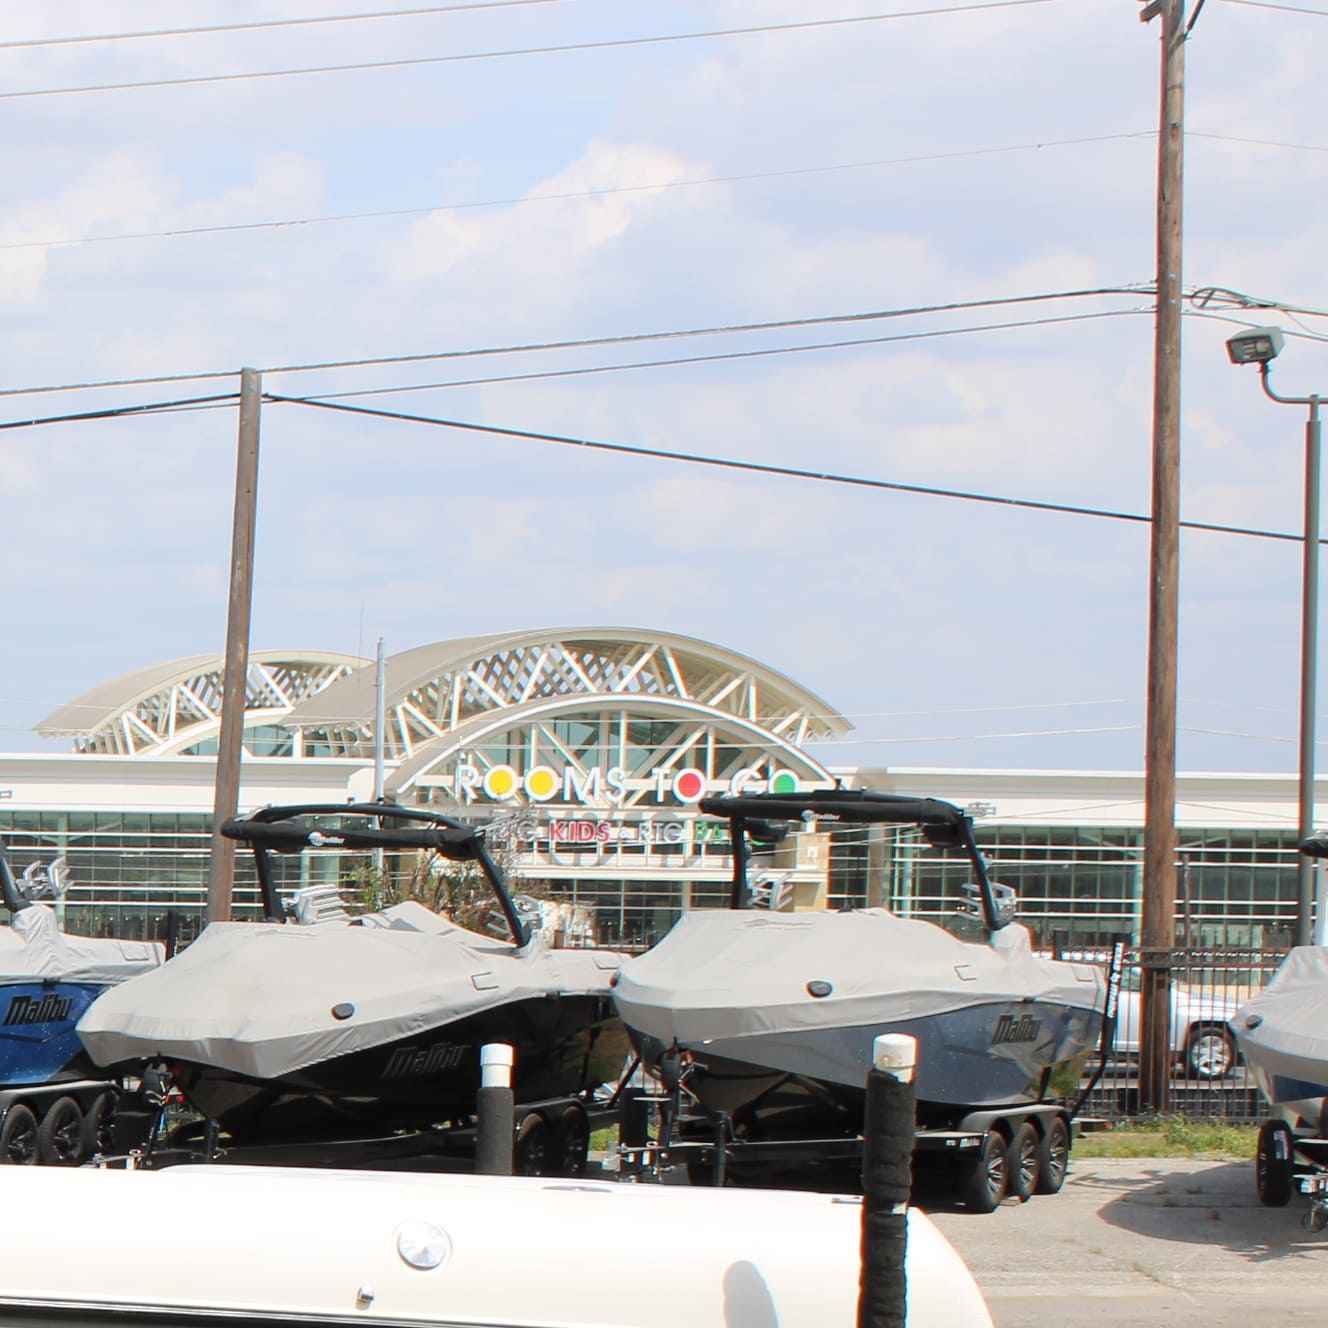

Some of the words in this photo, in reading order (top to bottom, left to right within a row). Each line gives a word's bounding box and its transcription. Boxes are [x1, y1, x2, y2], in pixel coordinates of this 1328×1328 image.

[455, 764, 626, 802] ROOMS
[652, 767, 706, 804] TO
[730, 769, 800, 798] GO
[549, 821, 611, 843] KIDS
[3, 994, 74, 1025] Malibu
